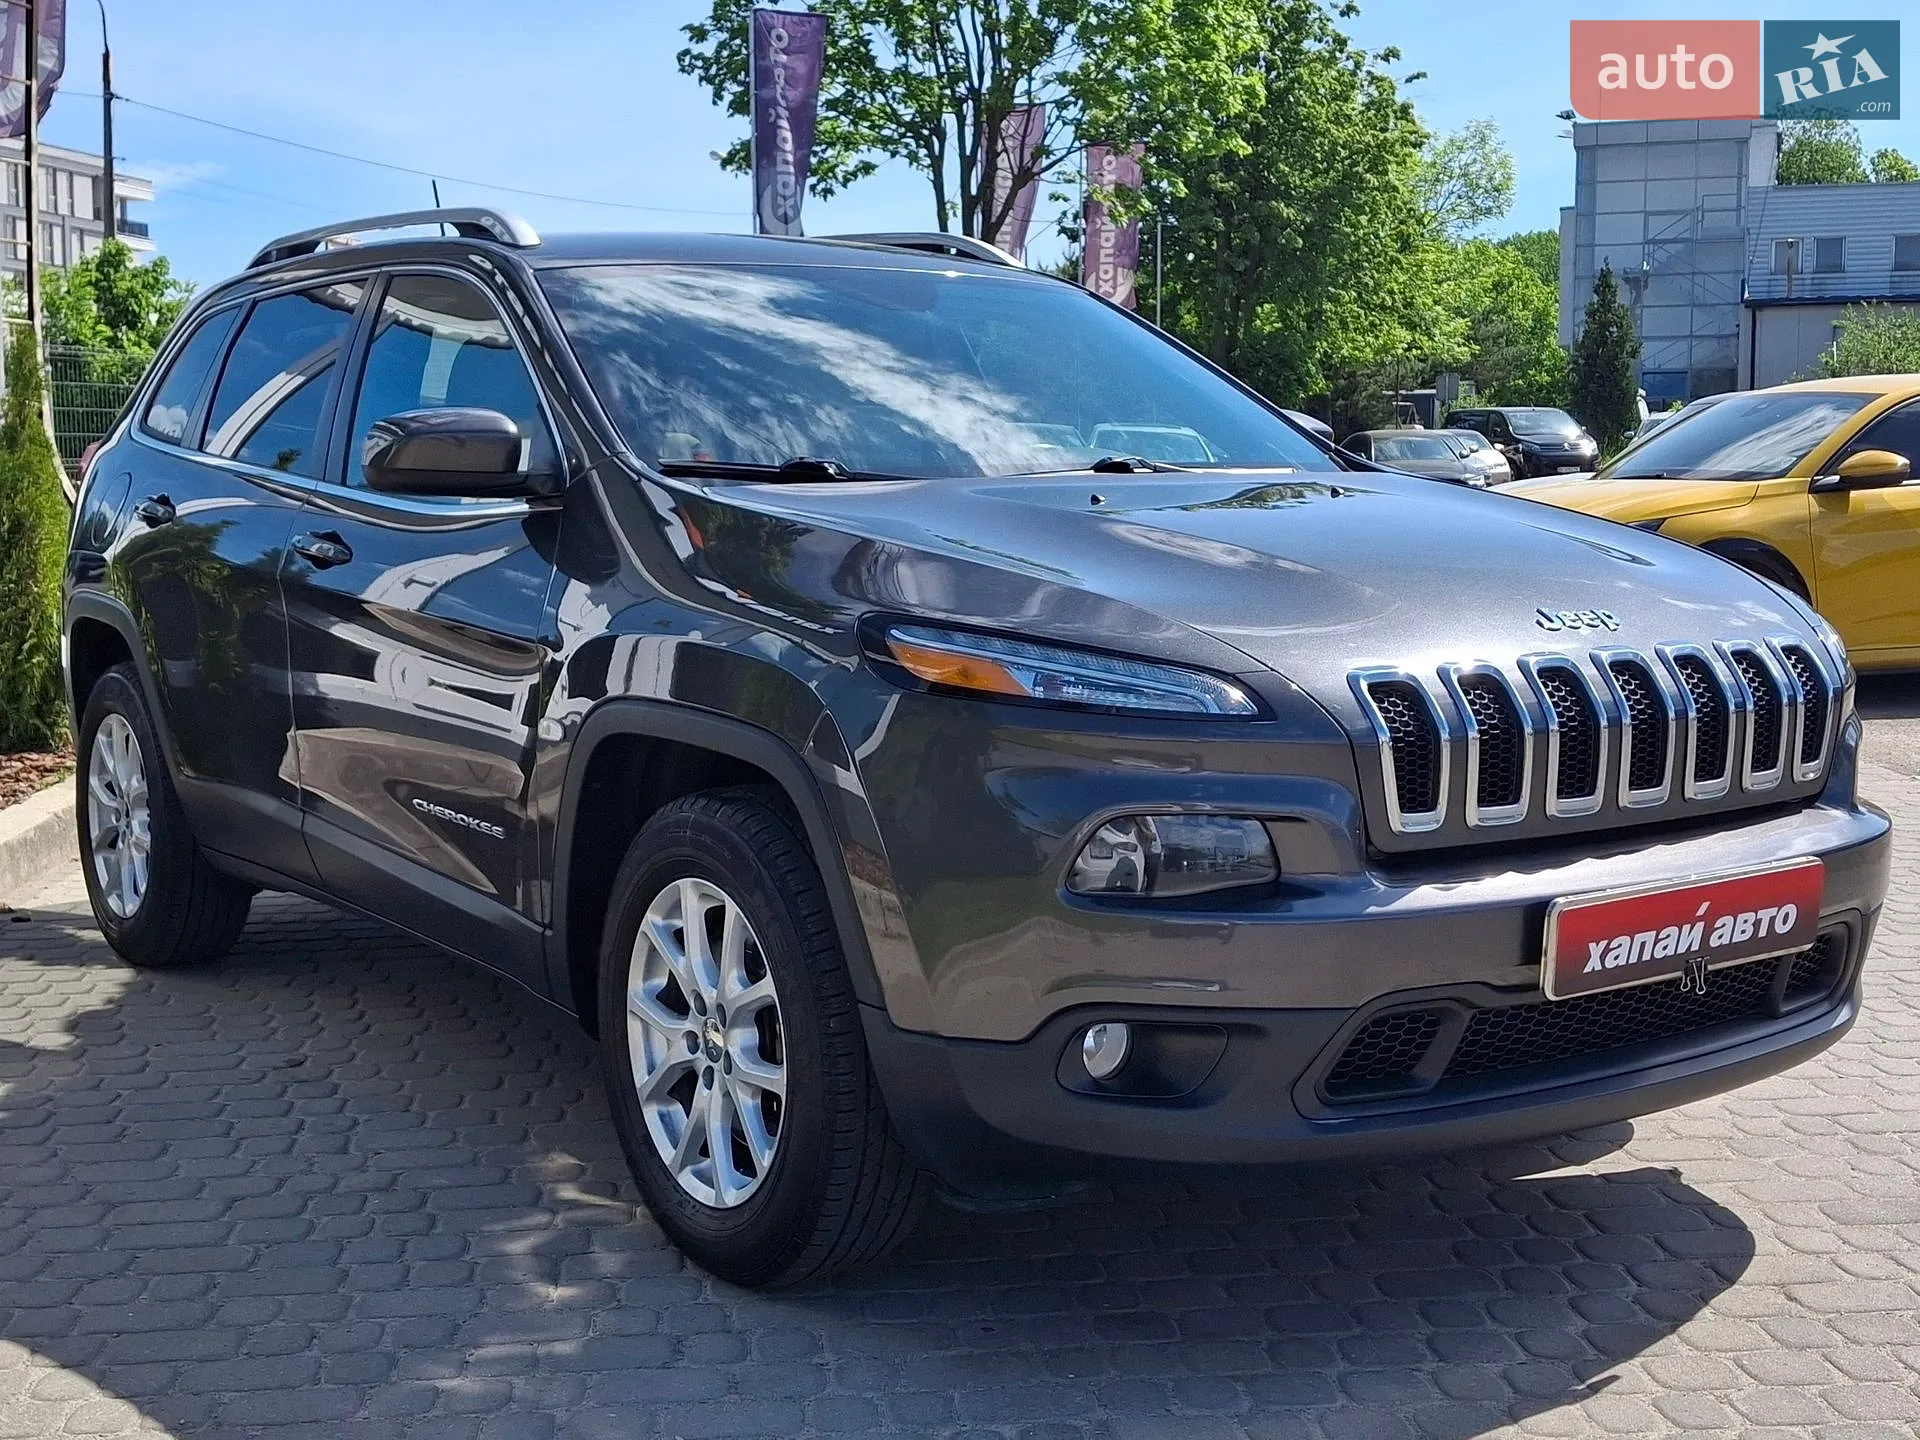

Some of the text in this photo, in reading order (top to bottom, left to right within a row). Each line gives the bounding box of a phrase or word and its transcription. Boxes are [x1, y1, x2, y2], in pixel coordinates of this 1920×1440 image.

[1535, 607, 1621, 632] Jeep
[412, 798, 506, 840] CHEROKEE
[1709, 901, 1798, 948] авто
